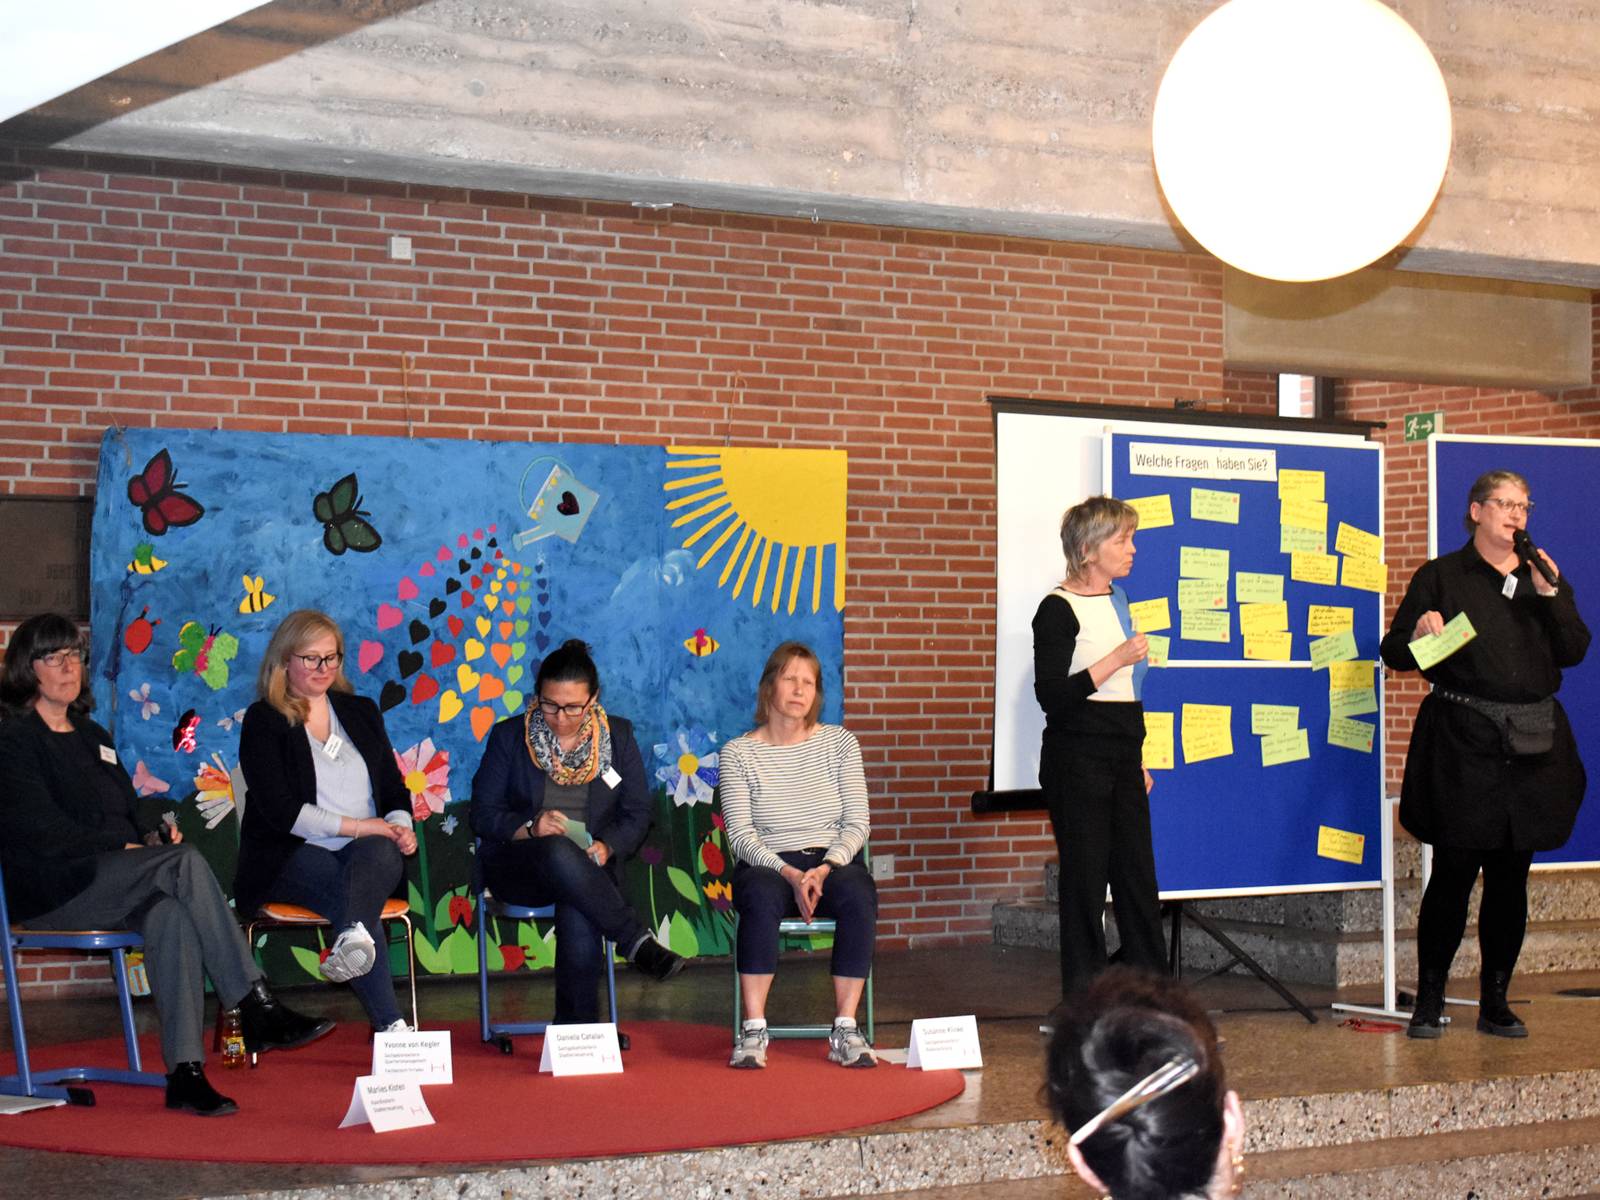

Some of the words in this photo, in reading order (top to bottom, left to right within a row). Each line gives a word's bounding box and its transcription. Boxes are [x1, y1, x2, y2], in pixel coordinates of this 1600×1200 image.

[1135, 453, 1173, 468] Welche
[1175, 455, 1209, 472] Fragen
[1216, 456, 1246, 471] haben
[1247, 458, 1268, 471] Sie?
[420, 1041, 440, 1049] Kegler
